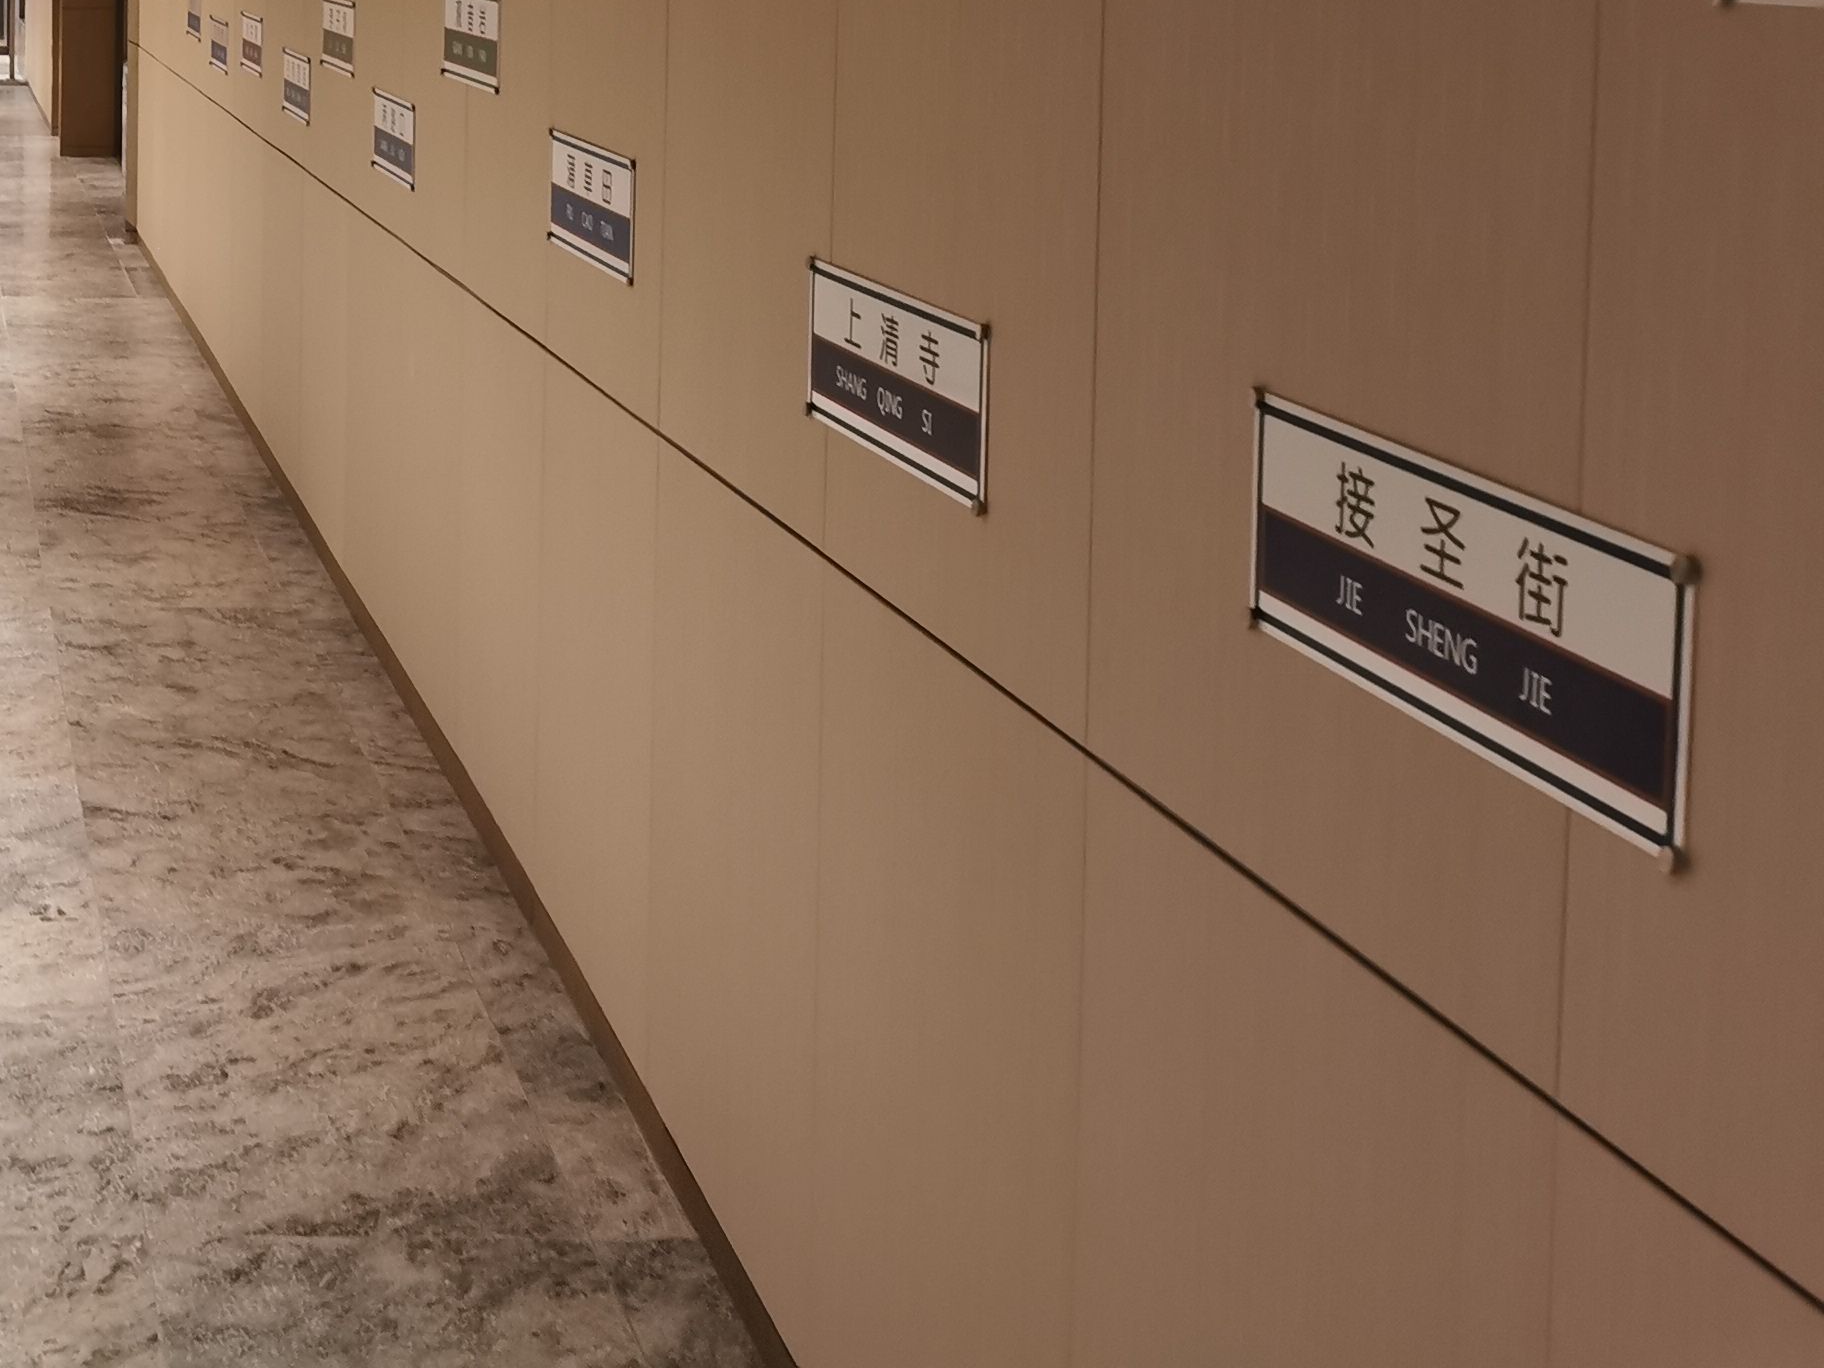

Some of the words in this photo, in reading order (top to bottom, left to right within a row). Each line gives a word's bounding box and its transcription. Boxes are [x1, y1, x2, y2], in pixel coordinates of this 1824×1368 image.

[843, 297, 941, 386] 上清寺
[835, 365, 868, 401] SHANG
[876, 386, 903, 420] QING
[921, 408, 934, 436] SI
[1334, 460, 1569, 639] 接圣街
[1336, 574, 1364, 617] JIE
[1404, 608, 1479, 676] SHENG
[1518, 666, 1553, 717] JIE
